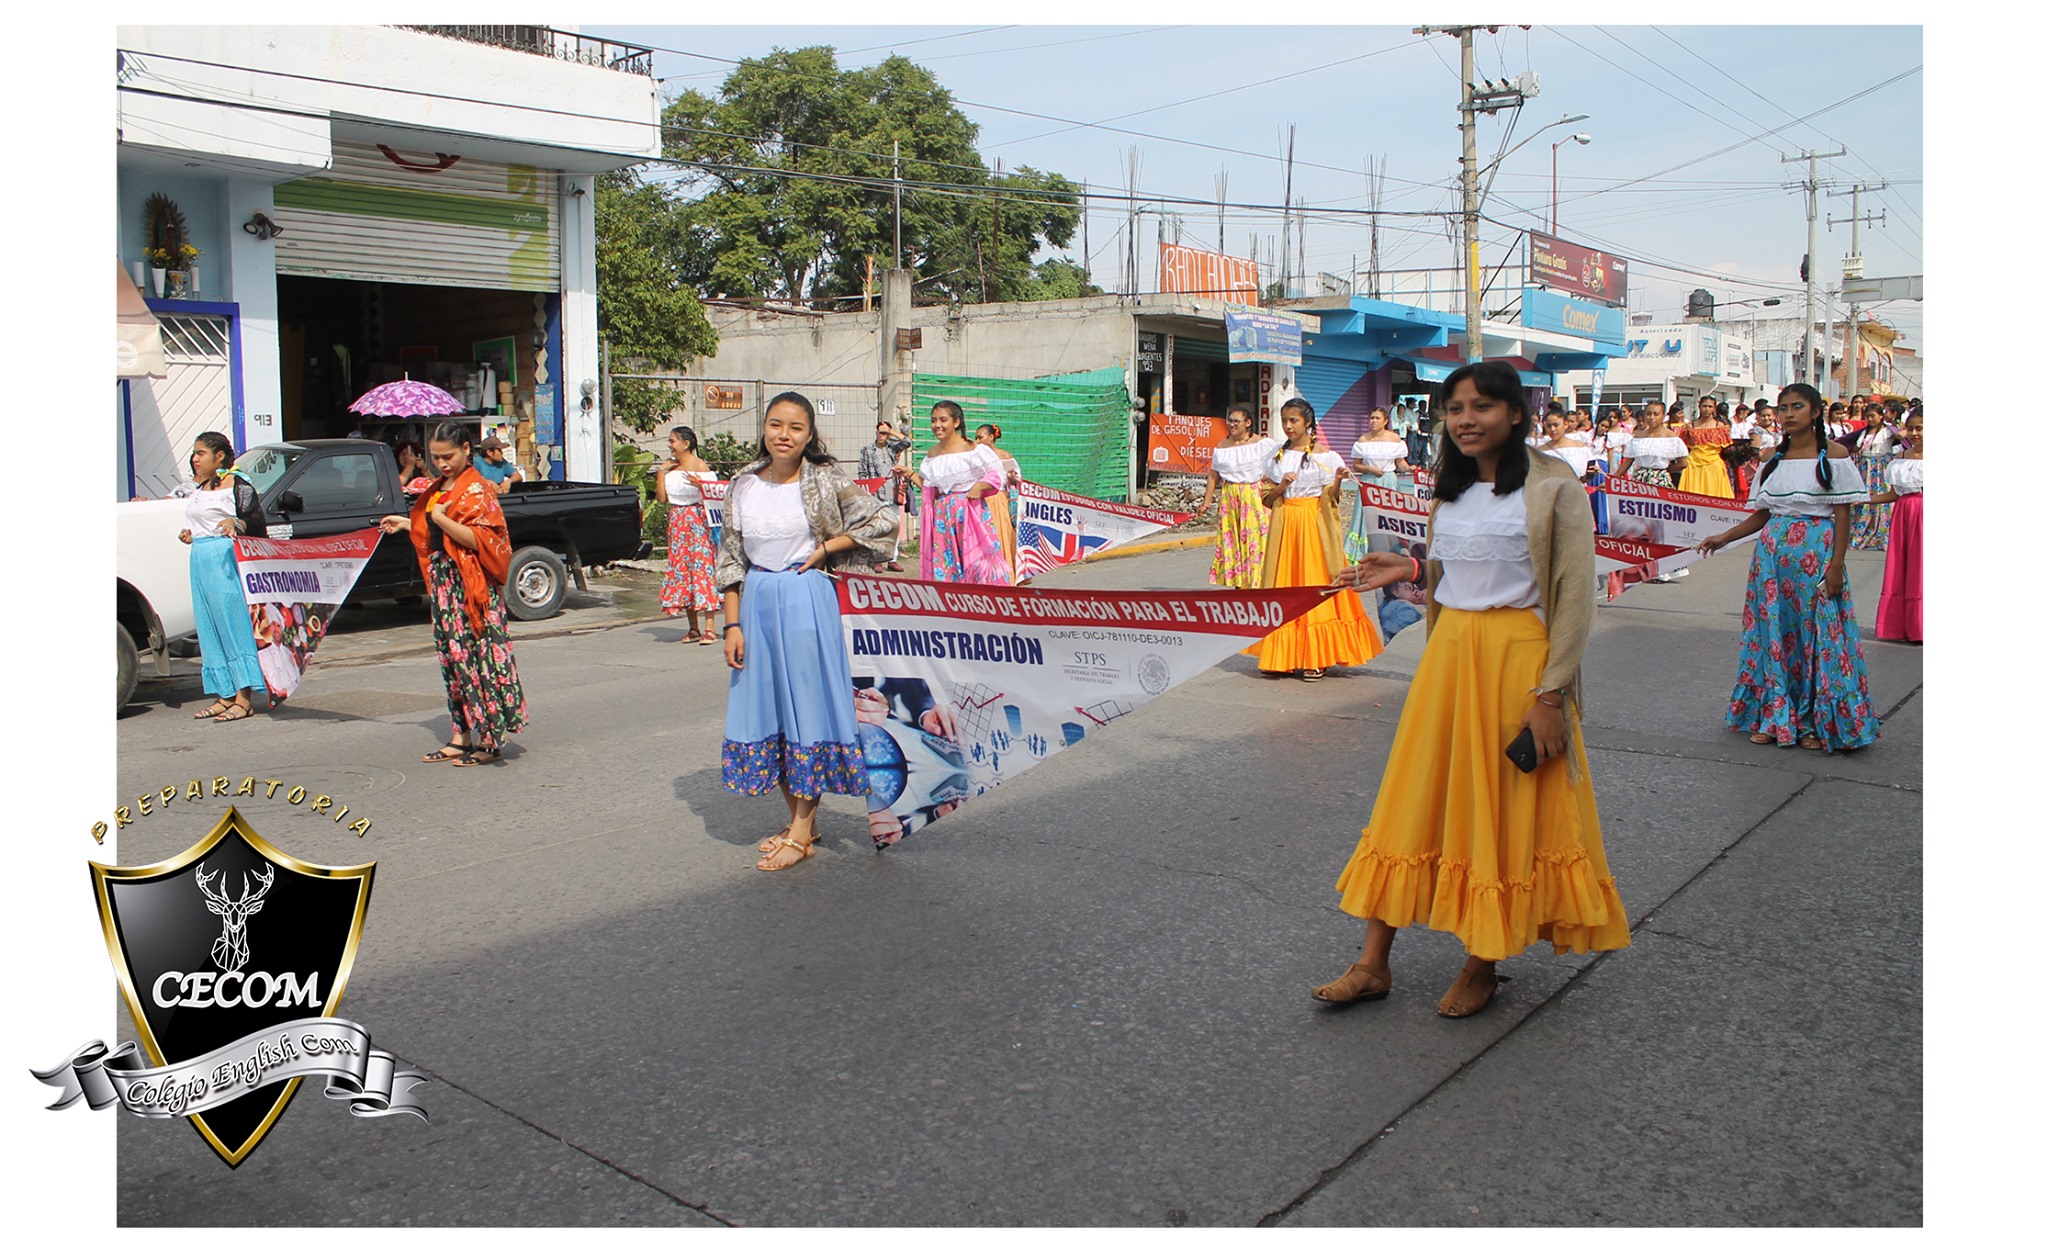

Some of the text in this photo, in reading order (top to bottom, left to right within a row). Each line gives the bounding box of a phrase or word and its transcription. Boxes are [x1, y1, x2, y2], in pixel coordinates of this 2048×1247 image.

[1563, 304, 1600, 334] Comex
[820, 400, 832, 411] 911
[1152, 425, 1210, 437] DE GASOLINA
[1168, 415, 1212, 427] TANQUES
[1180, 447, 1212, 458] DIESEL
[1020, 482, 1060, 500] CECOM
[1062, 493, 1095, 508] ESTUDIOS
[1097, 502, 1113, 512] CON
[1113, 505, 1146, 517] VALIDEZ
[1147, 510, 1175, 524] OFICIAL
[1610, 478, 1660, 497] CECOM
[1668, 492, 1710, 503] ESTUDIOS
[1712, 499, 1730, 507] CON
[1025, 502, 1072, 525] INGLES
[1618, 499, 1697, 524] ESTILISMO
[1598, 539, 1655, 561] OFICIAL
[246, 571, 321, 594] GASTRONOMIA
[847, 578, 1284, 627] CECOM CURSO DE FORMACIÓN PARA EL TRABAJO
[852, 629, 1044, 665] ADMINISTRACIÓN
[1048, 630, 1183, 646] CLAVE: OICJ-781110-DE3-0013
[1074, 651, 1106, 667] STPS
